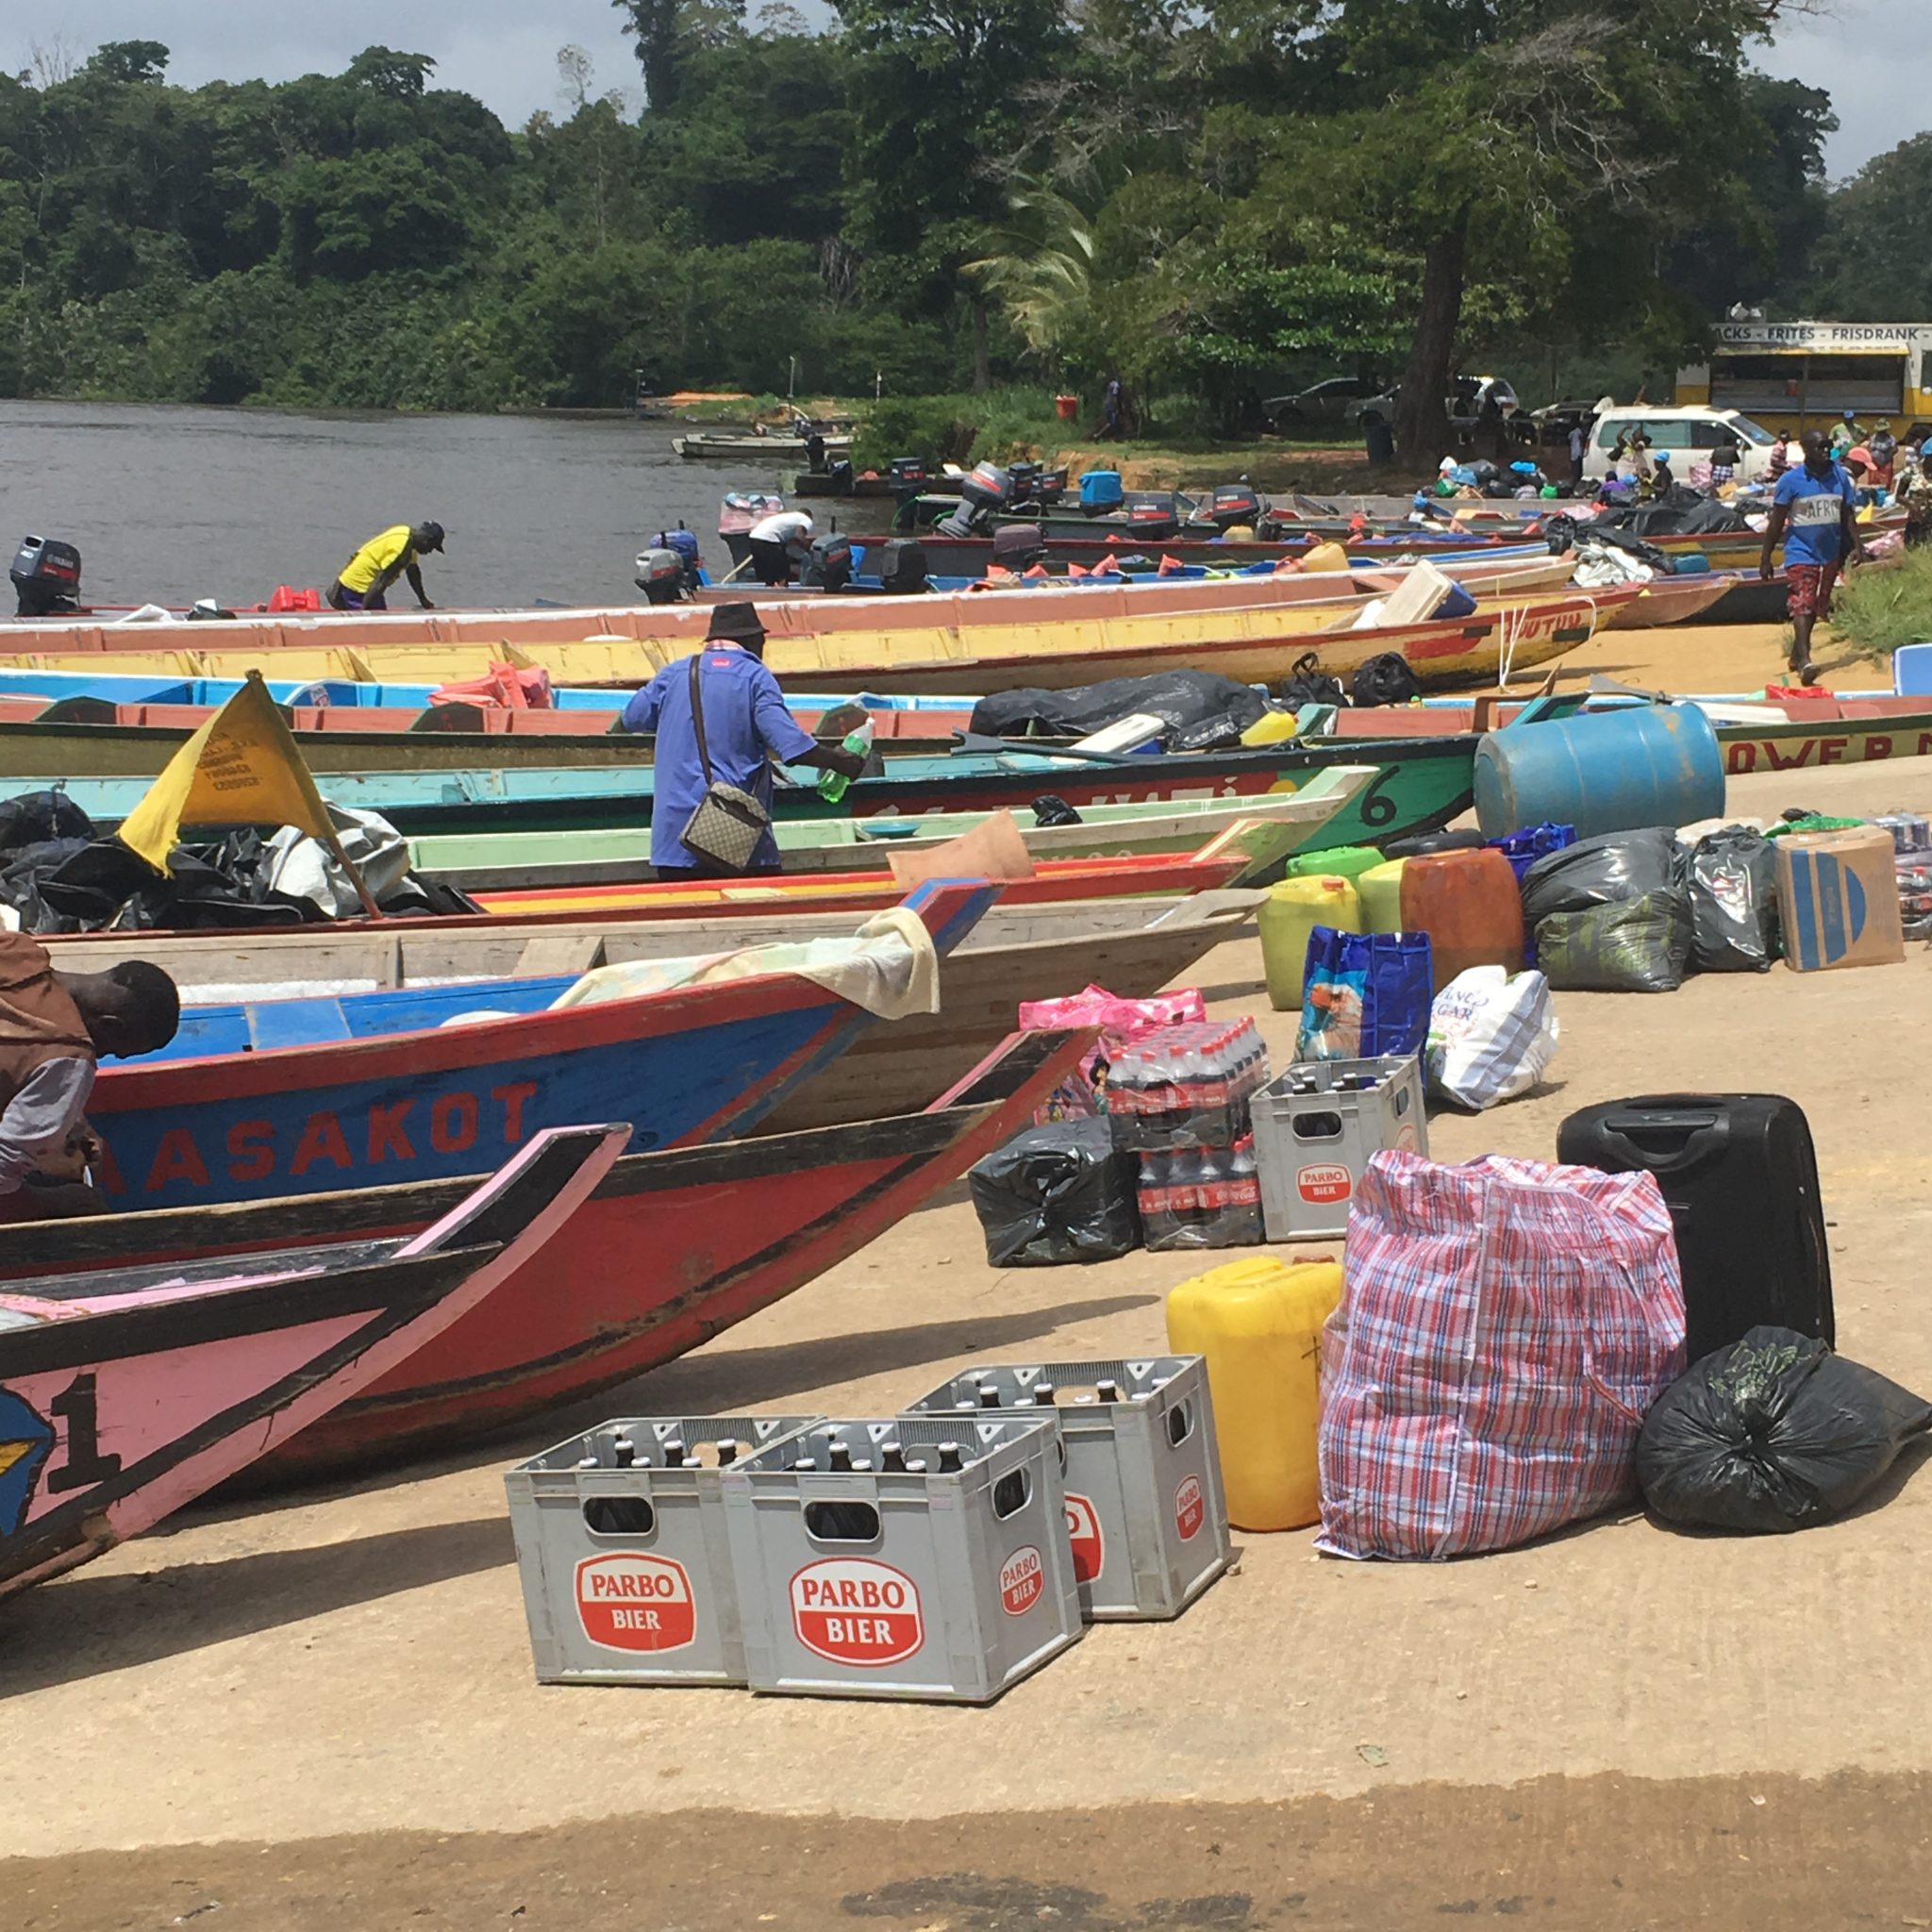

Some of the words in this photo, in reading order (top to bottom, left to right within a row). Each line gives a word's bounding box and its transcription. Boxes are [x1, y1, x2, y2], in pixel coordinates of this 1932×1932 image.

[1767, 327, 1816, 340] FRITES
[1831, 327, 1919, 341] FRISDRANK
[1360, 764, 1400, 827] 6
[1304, 1172, 1343, 1184] PARBO
[1312, 1186, 1337, 1196] BIER
[1002, 1554, 1038, 1588] PARBO
[591, 1574, 675, 1598] PARBO
[801, 1578, 906, 1609] PARBO
[1011, 1579, 1036, 1605] BIER
[611, 1609, 662, 1630] BIER
[825, 1617, 895, 1645] BIER
